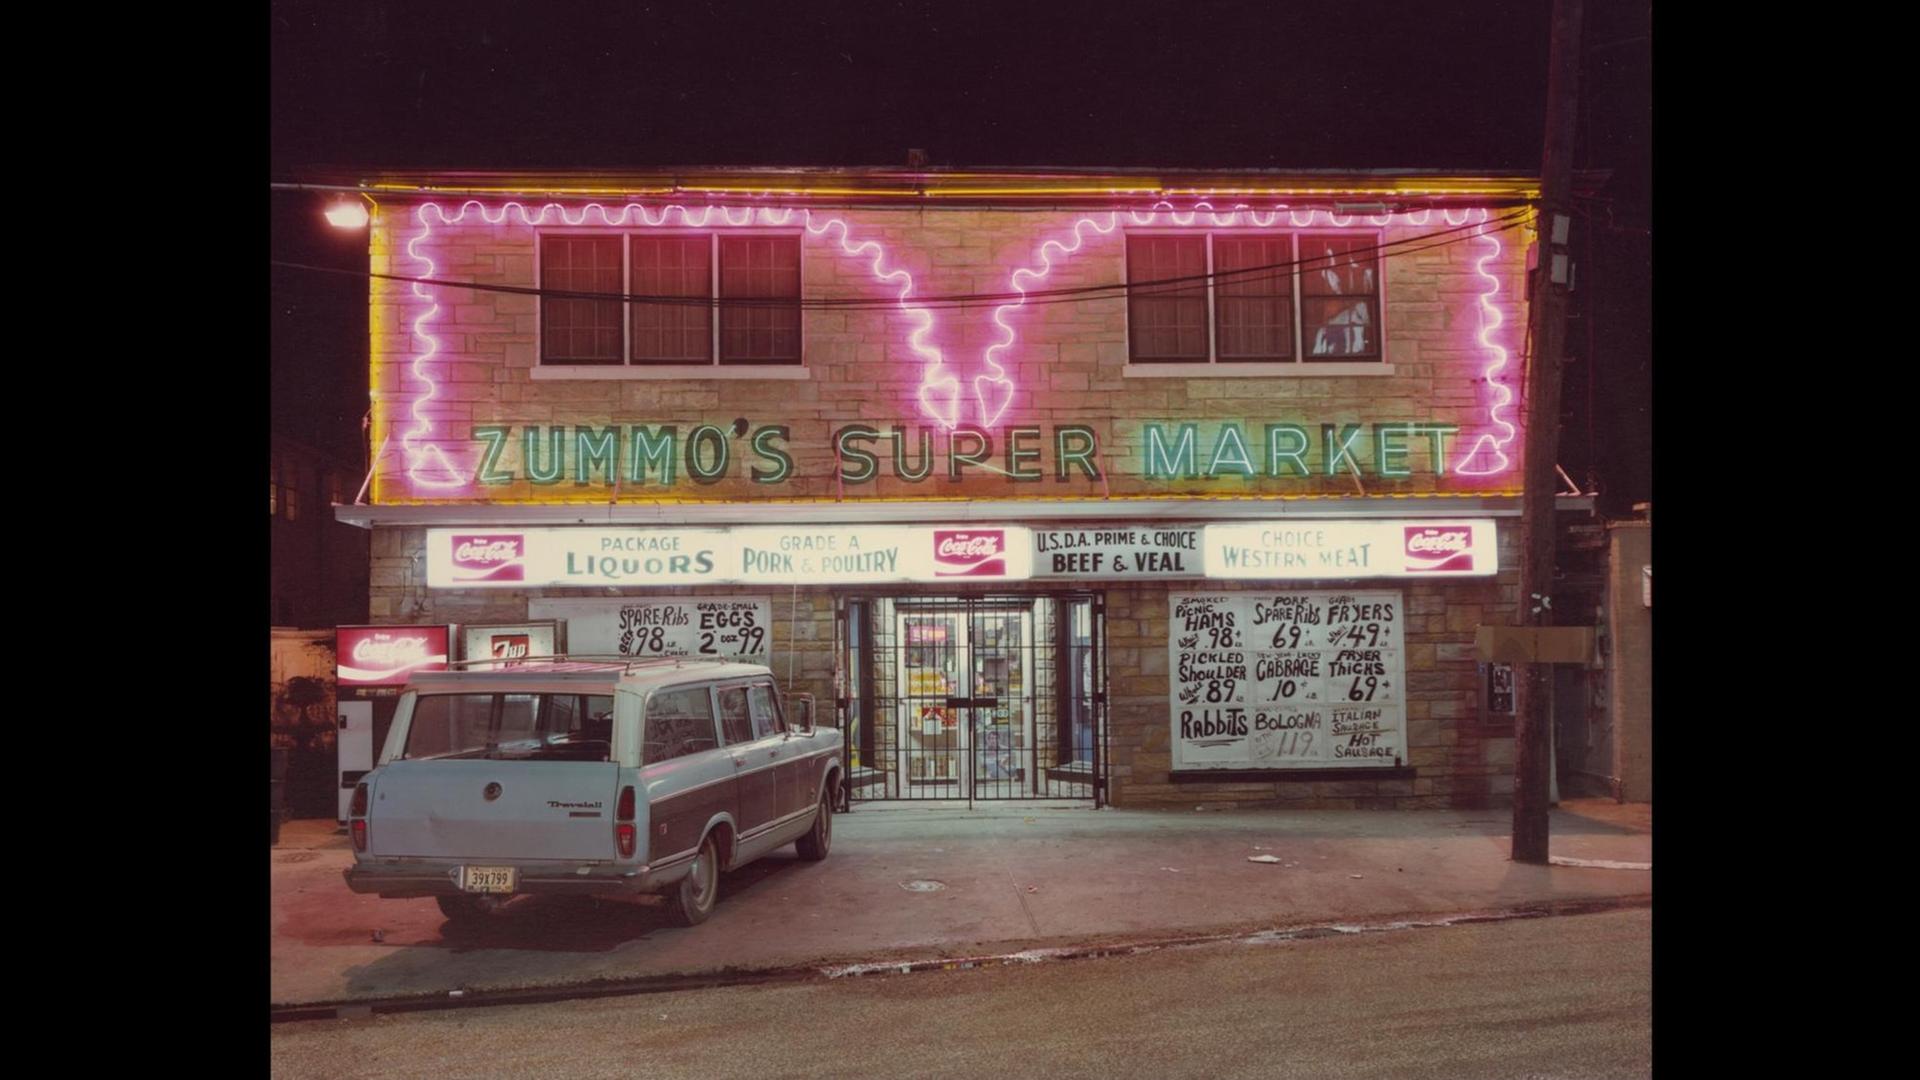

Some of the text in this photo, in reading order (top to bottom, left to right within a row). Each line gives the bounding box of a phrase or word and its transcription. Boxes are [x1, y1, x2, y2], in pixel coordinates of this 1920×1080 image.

[471, 417, 1459, 486] ZUMMO'S SUPER MARKET
[601, 536, 681, 551] PACKAGE
[779, 534, 860, 551] GRADE A
[938, 536, 999, 557] Coca-Cola
[1037, 531, 1197, 553] U.S.D.A. PRIME & CHOICE
[1261, 530, 1325, 548] CHOICE
[567, 549, 714, 577] LIQUORS
[743, 547, 899, 574] PORK & POULTRY
[1052, 552, 1186, 574] BEEF & VEAL
[1222, 543, 1370, 568] WESTERN MEAT
[1273, 596, 1309, 607] PORK
[700, 611, 755, 630] EGGS
[1184, 611, 1236, 632] HAMS
[1327, 603, 1394, 626] FRYERS
[699, 631, 718, 654] 2
[720, 634, 739, 643] DOZ
[1178, 651, 1244, 666] PICKLED
[1336, 649, 1382, 663] FRYER
[1256, 658, 1320, 681] CABBAGE
[1331, 709, 1382, 723] ITALIAN
[1334, 744, 1394, 759] SAUSAGE
[546, 800, 603, 809] Travelall
[471, 871, 509, 886] 39X799
